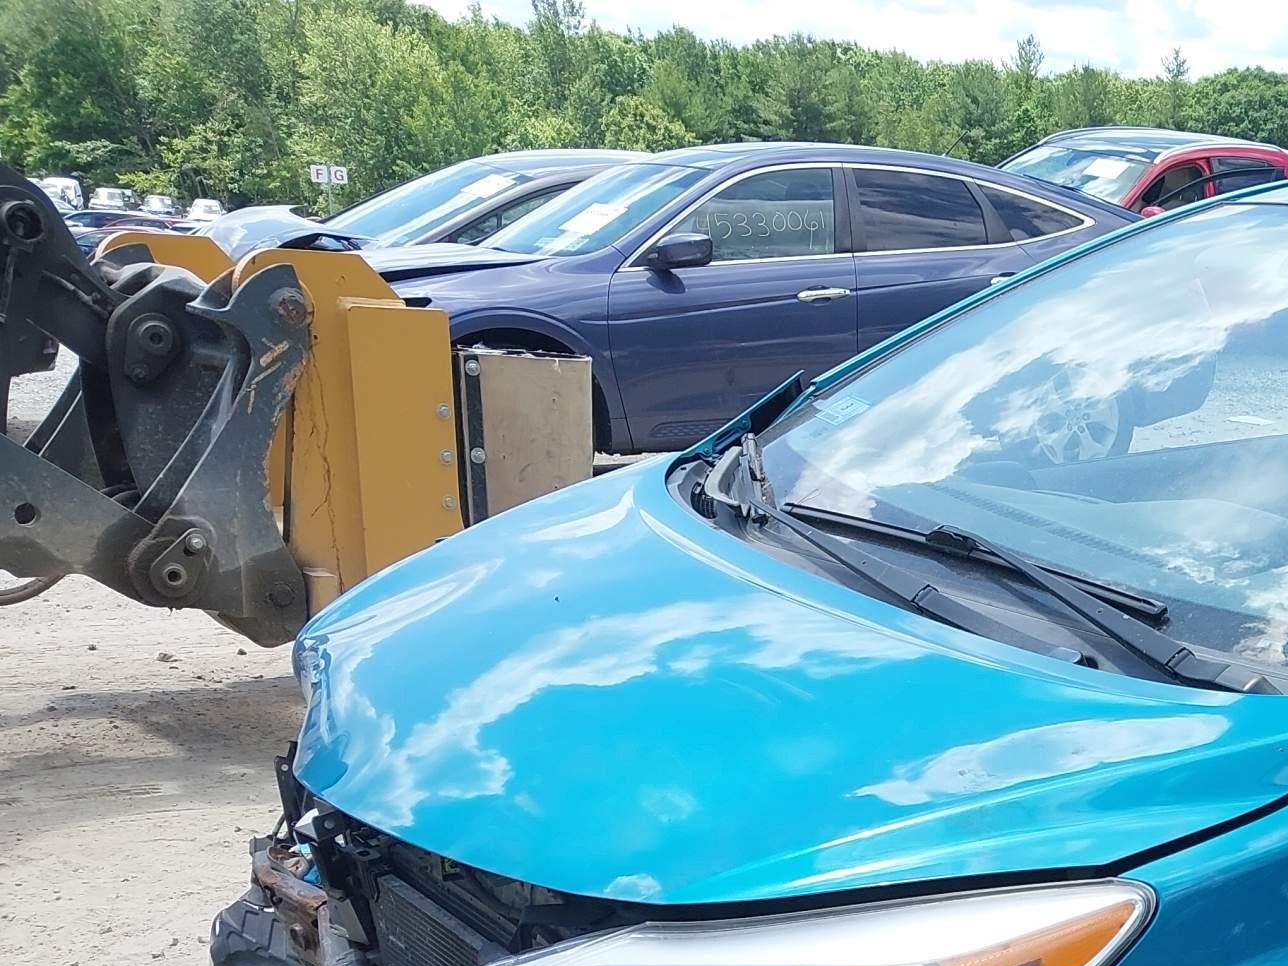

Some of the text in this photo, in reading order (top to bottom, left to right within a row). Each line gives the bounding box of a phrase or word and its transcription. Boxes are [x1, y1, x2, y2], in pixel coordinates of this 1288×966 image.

[315, 168, 323, 180] F
[334, 169, 344, 181] G
[696, 209, 825, 242] 45330061
